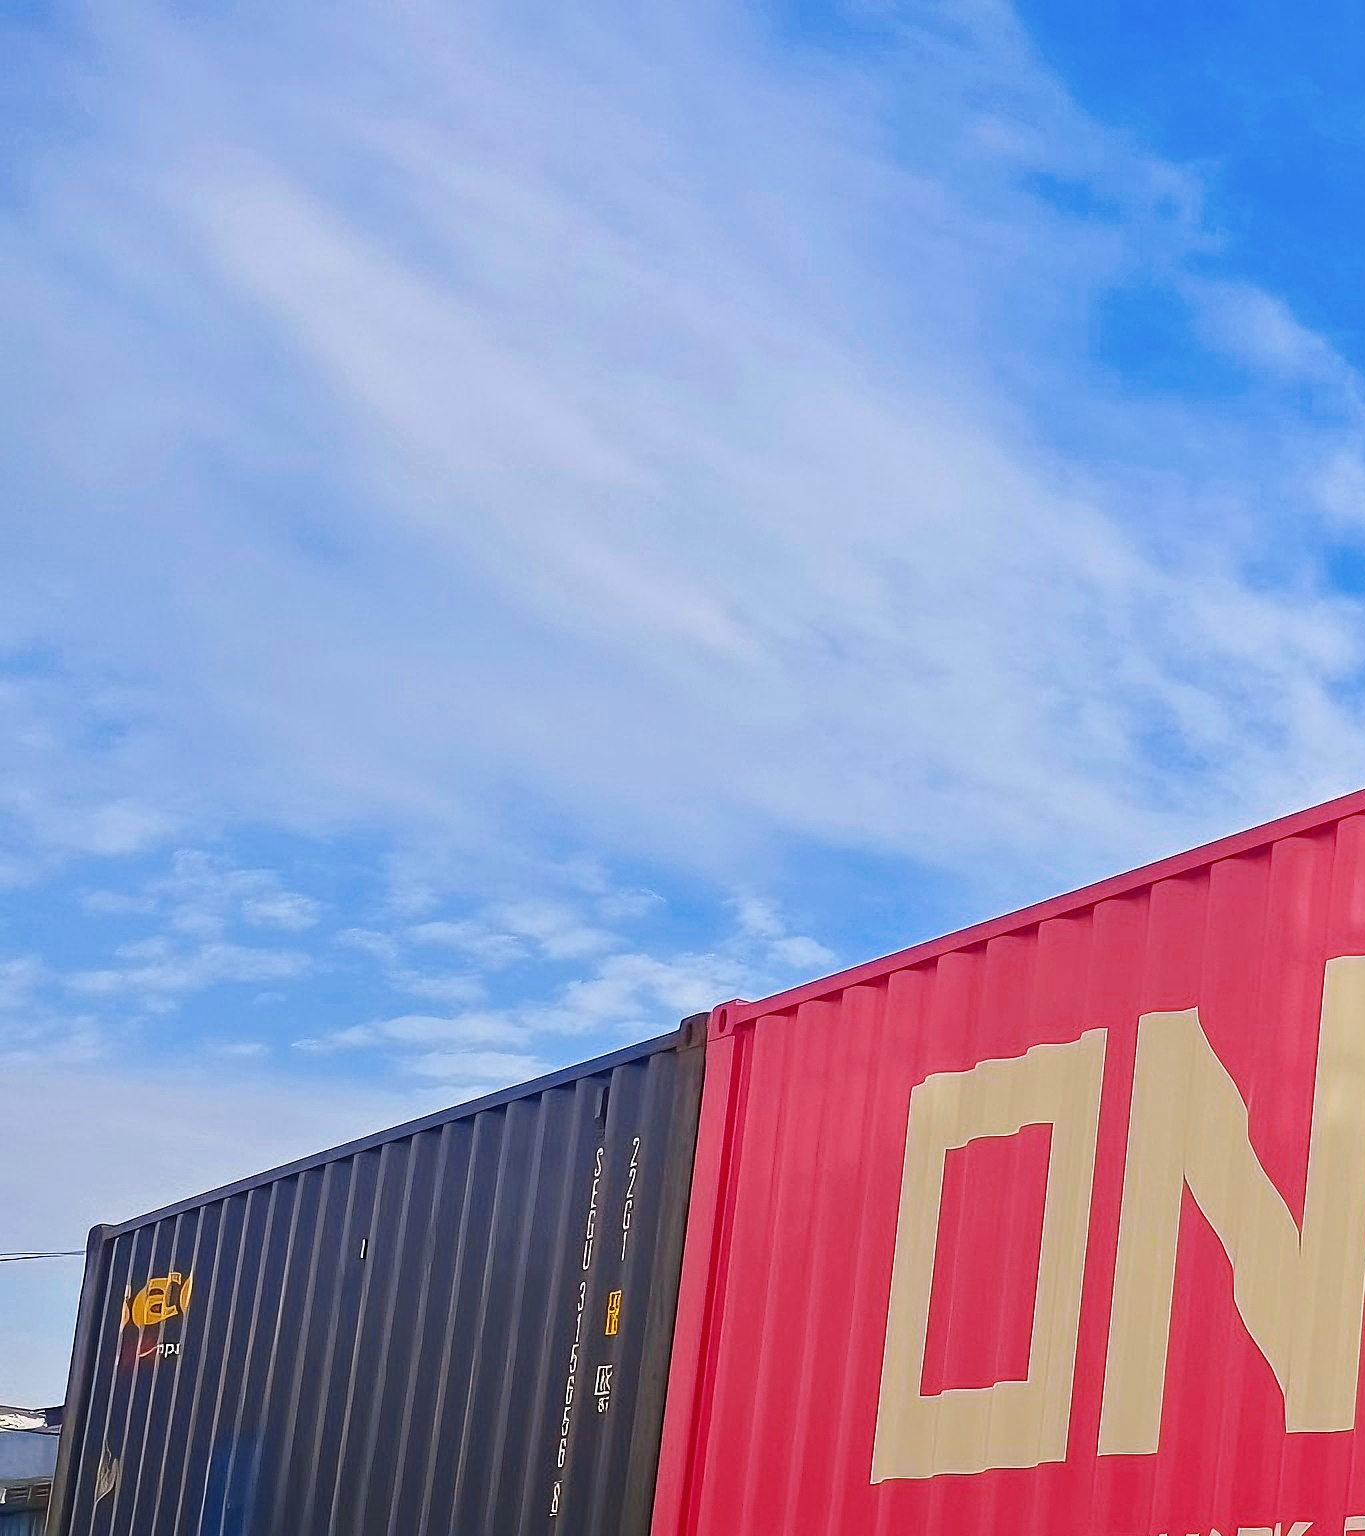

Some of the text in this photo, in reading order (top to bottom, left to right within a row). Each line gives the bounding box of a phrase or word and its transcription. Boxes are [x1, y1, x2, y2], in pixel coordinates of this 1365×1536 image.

[582, 1147, 604, 1270] SEGU
[620, 1137, 640, 1261] 22G1
[557, 1281, 586, 1468] 315656
